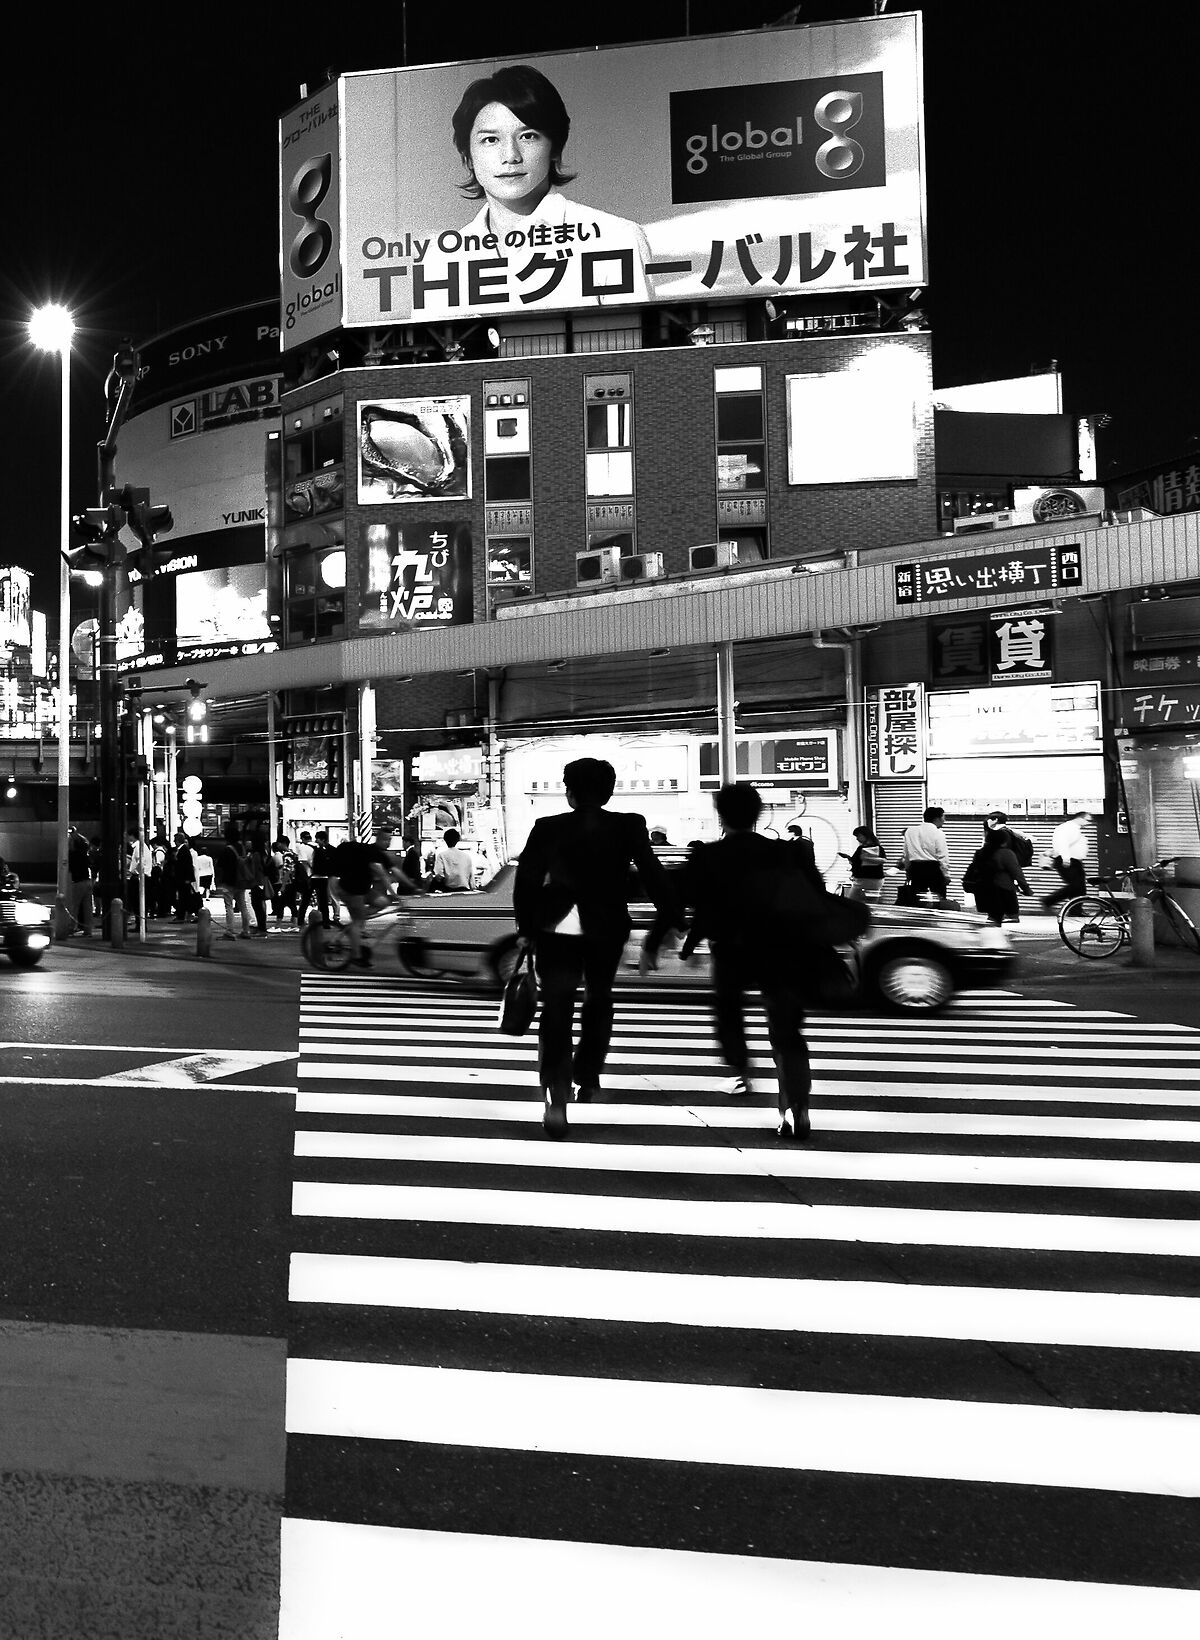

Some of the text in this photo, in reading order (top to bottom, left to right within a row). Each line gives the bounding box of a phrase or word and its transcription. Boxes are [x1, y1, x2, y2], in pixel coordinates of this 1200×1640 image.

[300, 103, 320, 124] THE
[686, 116, 803, 174] global
[737, 152, 764, 161] Global
[766, 150, 792, 160] Group
[362, 222, 601, 262] Only One の住まい
[285, 273, 339, 329] global
[169, 336, 228, 366] SONY
[429, 531, 450, 567] ちび
[1061, 551, 1079, 580] 西口
[896, 571, 912, 598] 新宿
[925, 561, 1048, 595] 思い出横丁
[995, 619, 1045, 671] 貸
[883, 689, 918, 775] 部屋探し
